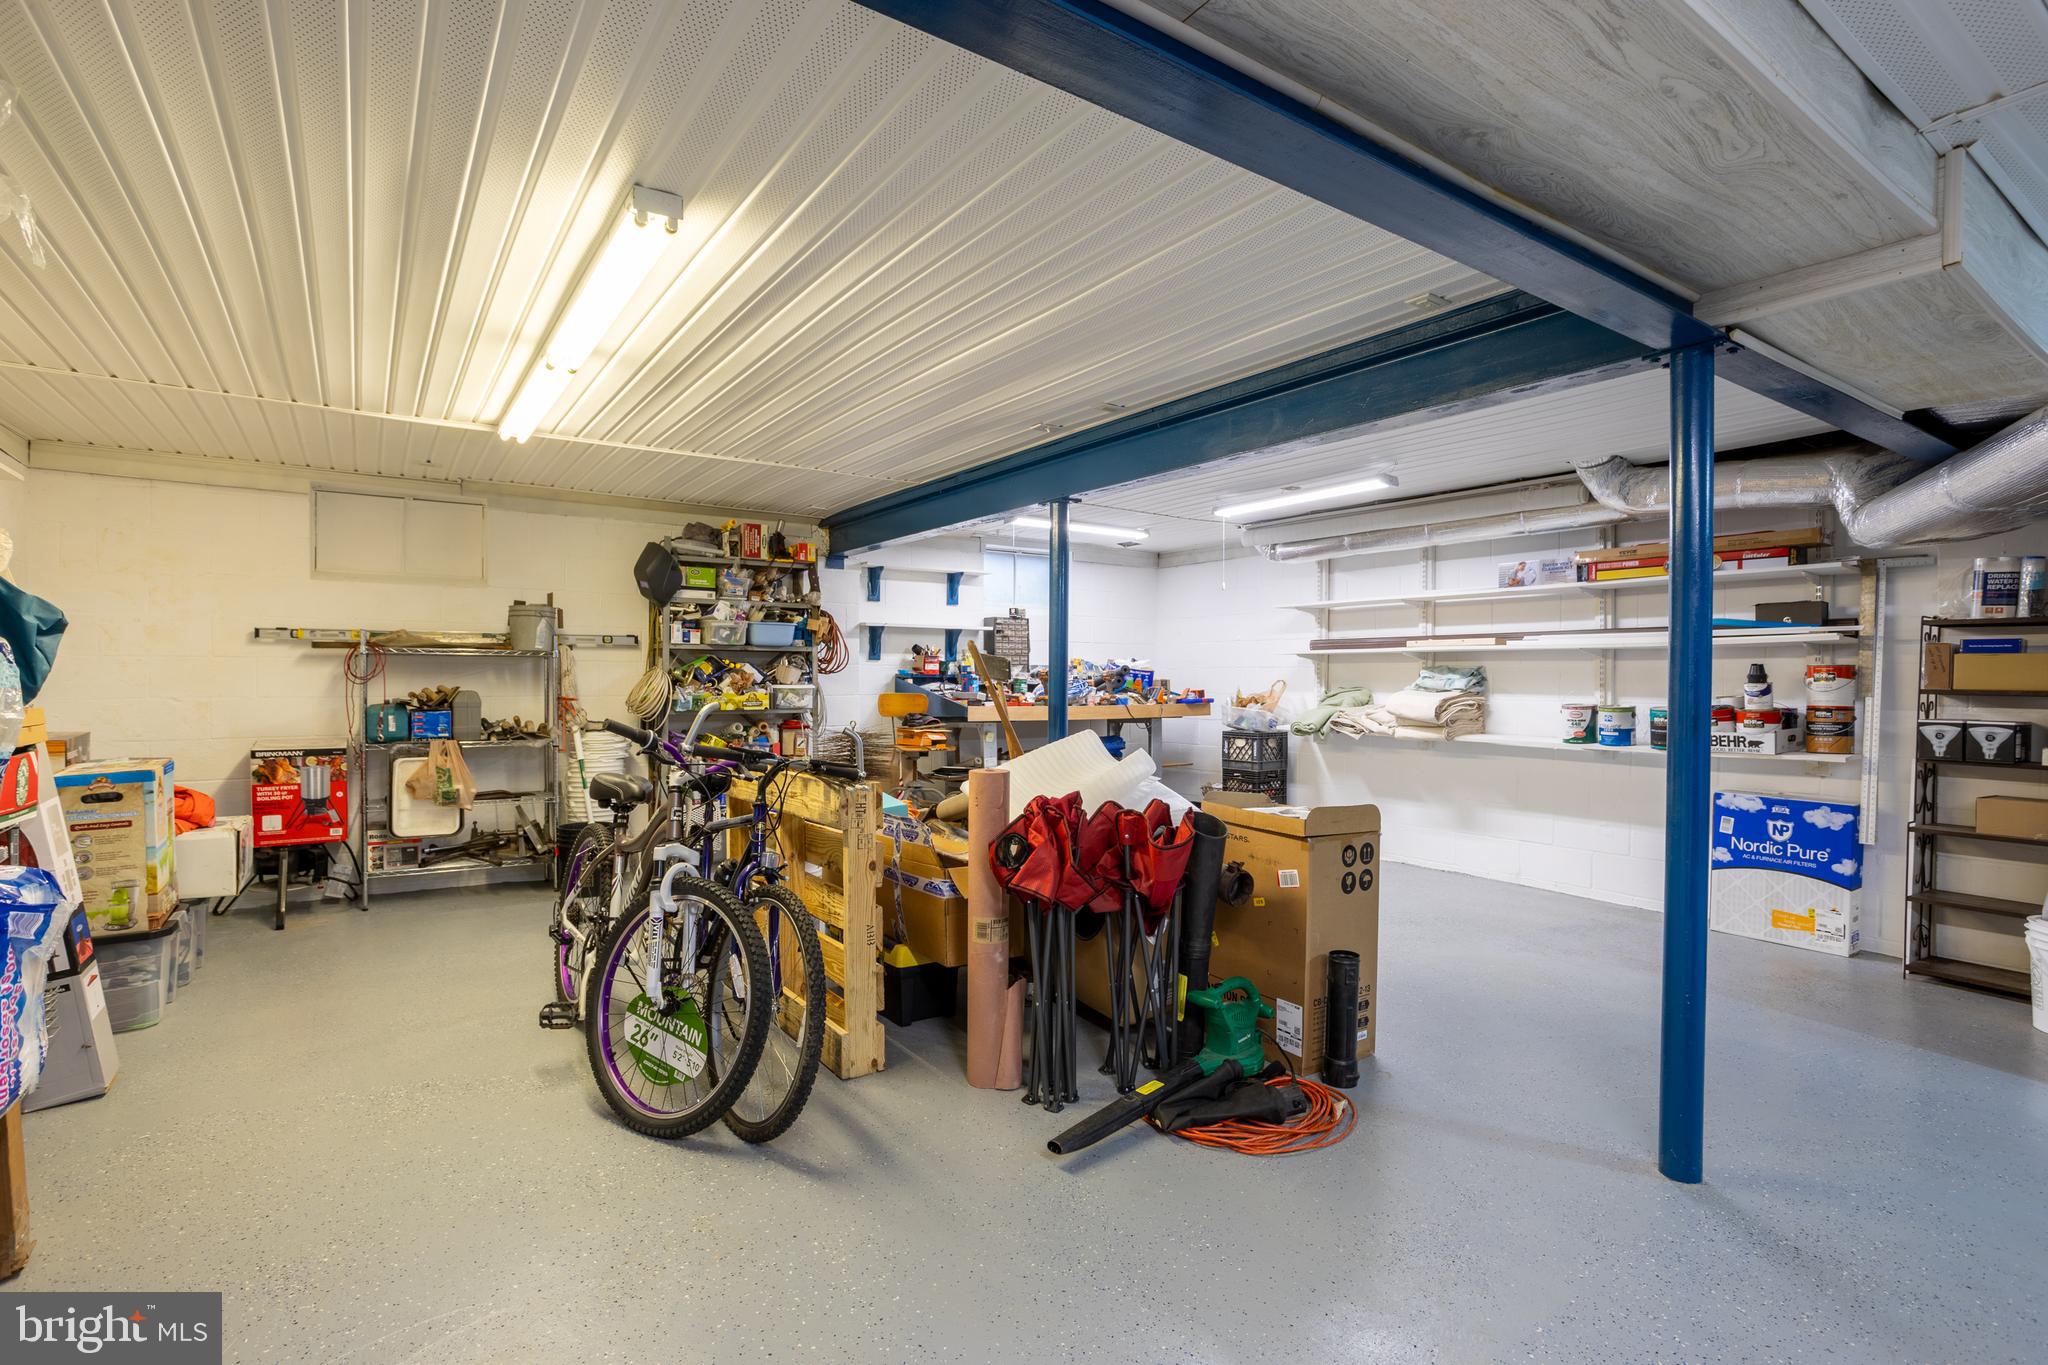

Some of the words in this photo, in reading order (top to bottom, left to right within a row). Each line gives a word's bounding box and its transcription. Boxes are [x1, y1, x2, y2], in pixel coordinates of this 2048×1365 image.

[1711, 735, 1747, 748] BEHR
[1772, 823, 1789, 837] NP
[1730, 836, 1783, 856] Nordic
[1787, 843, 1829, 862] Pure
[1793, 860, 1817, 868] FILTERS
[637, 1000, 703, 1047] MOUNTAIN
